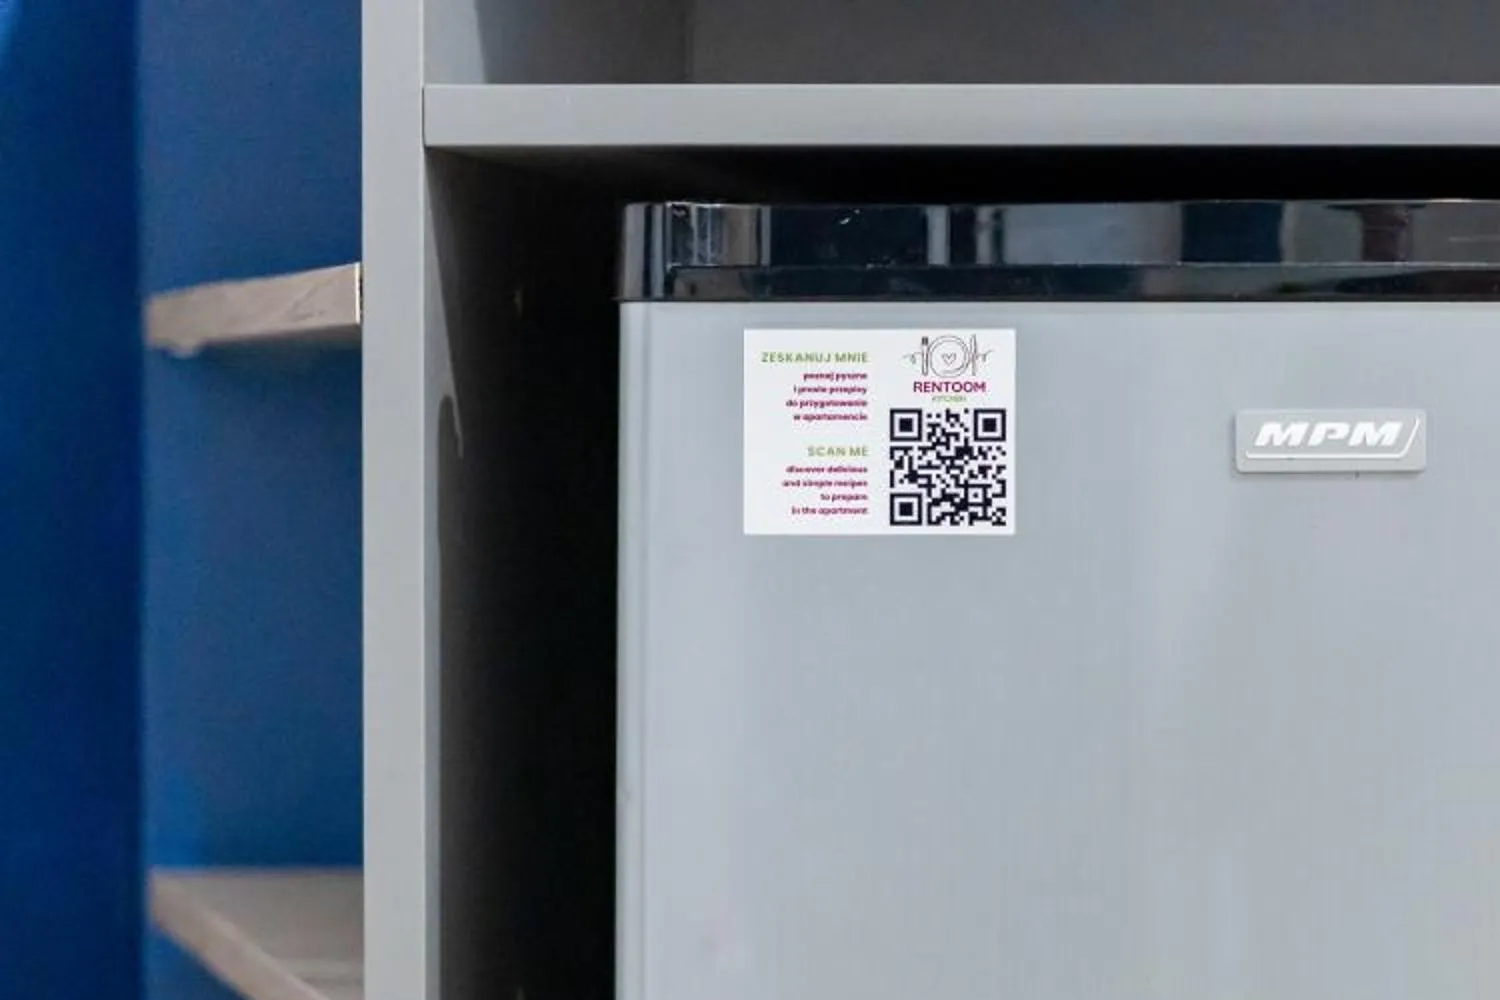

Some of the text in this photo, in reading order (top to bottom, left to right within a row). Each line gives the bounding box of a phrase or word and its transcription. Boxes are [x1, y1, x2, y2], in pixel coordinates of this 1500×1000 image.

[761, 352, 868, 362] ZESKANUJ MNIE
[913, 381, 986, 392] RENTOOM
[1255, 422, 1402, 446] MPM
[807, 446, 869, 457] SCAN ME
[820, 493, 830, 501] to
[802, 506, 816, 514] the
